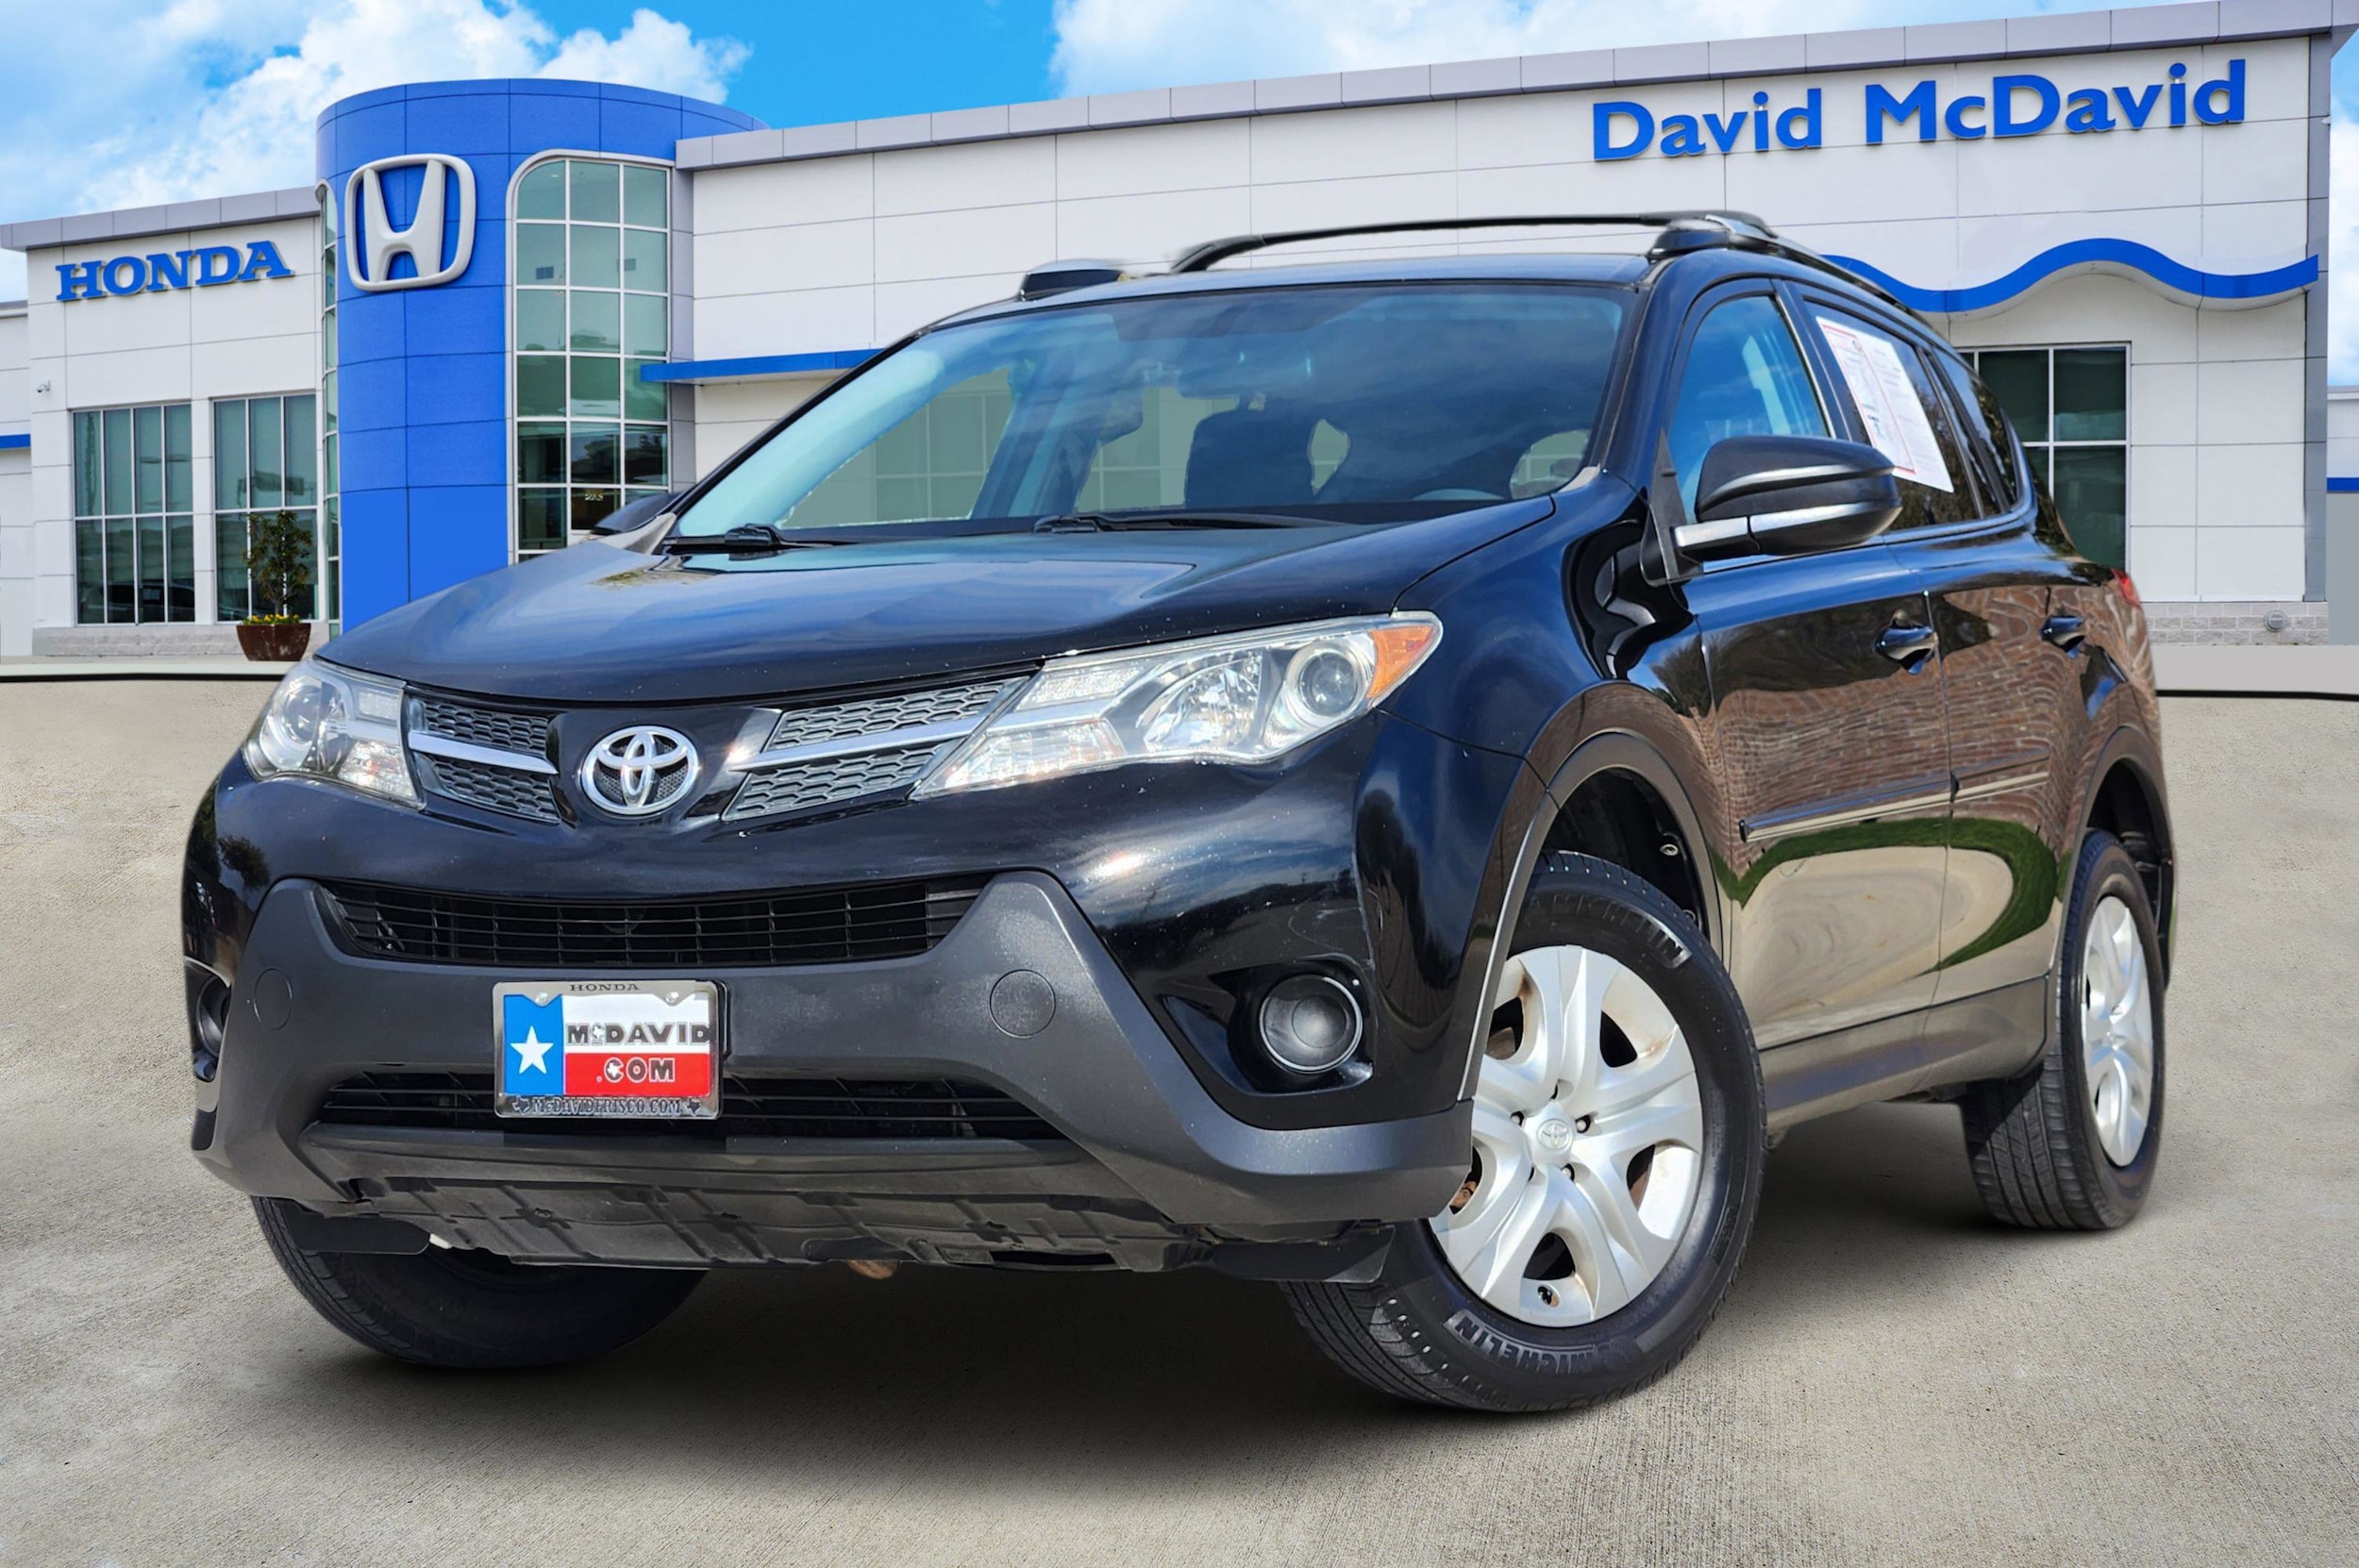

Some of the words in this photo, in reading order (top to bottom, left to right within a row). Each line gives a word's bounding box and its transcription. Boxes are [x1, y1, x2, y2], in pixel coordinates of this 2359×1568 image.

[1593, 88, 1822, 161] David
[1865, 58, 2247, 145] McDavid
[56, 240, 293, 302] HONDA
[569, 983, 640, 992] HONDA
